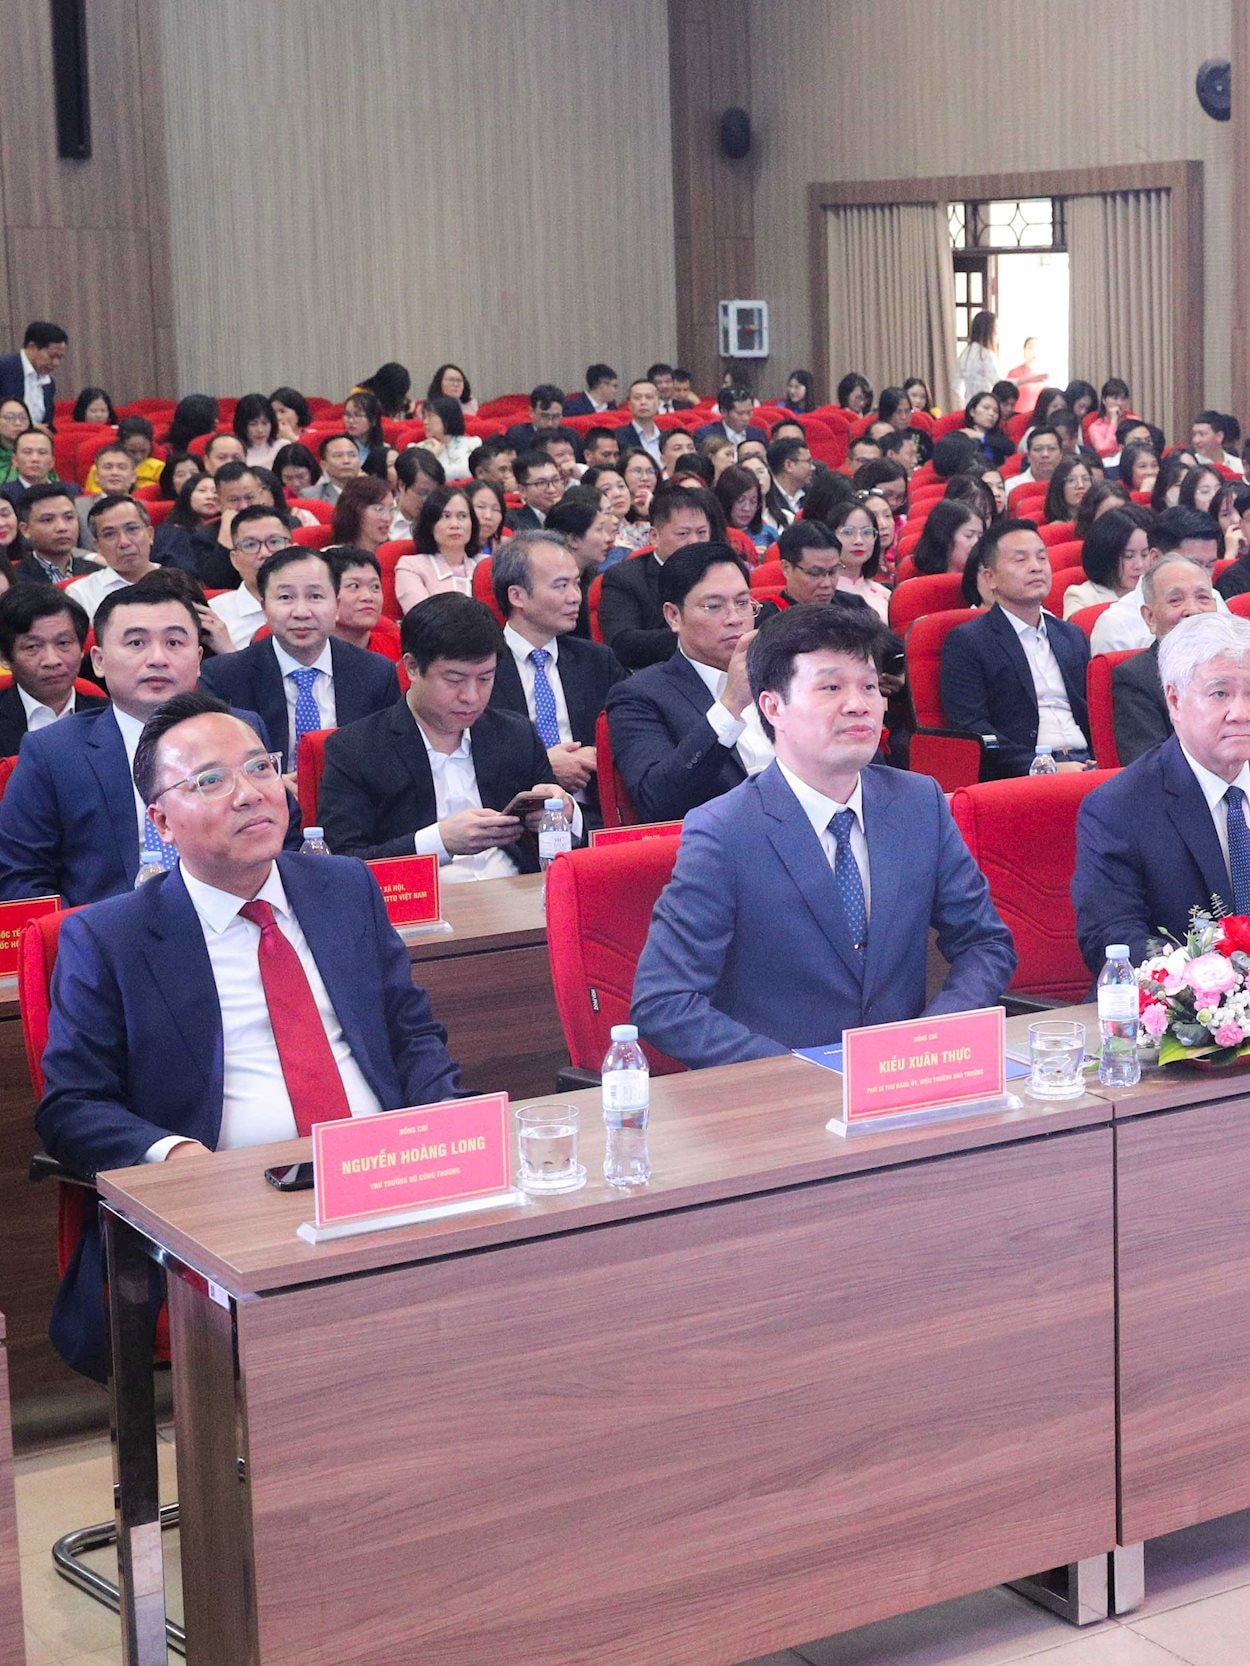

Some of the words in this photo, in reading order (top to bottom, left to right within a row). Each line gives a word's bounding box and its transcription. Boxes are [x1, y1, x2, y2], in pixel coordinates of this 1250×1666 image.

[399, 891, 412, 901] VIỆT
[413, 891, 427, 899] NAM
[909, 1051, 938, 1069] XUÂN
[942, 1046, 971, 1064] THỰC
[342, 1148, 397, 1175] NGUYỄN
[401, 1143, 447, 1165] HOÀNG
[451, 1136, 486, 1155] LONG
